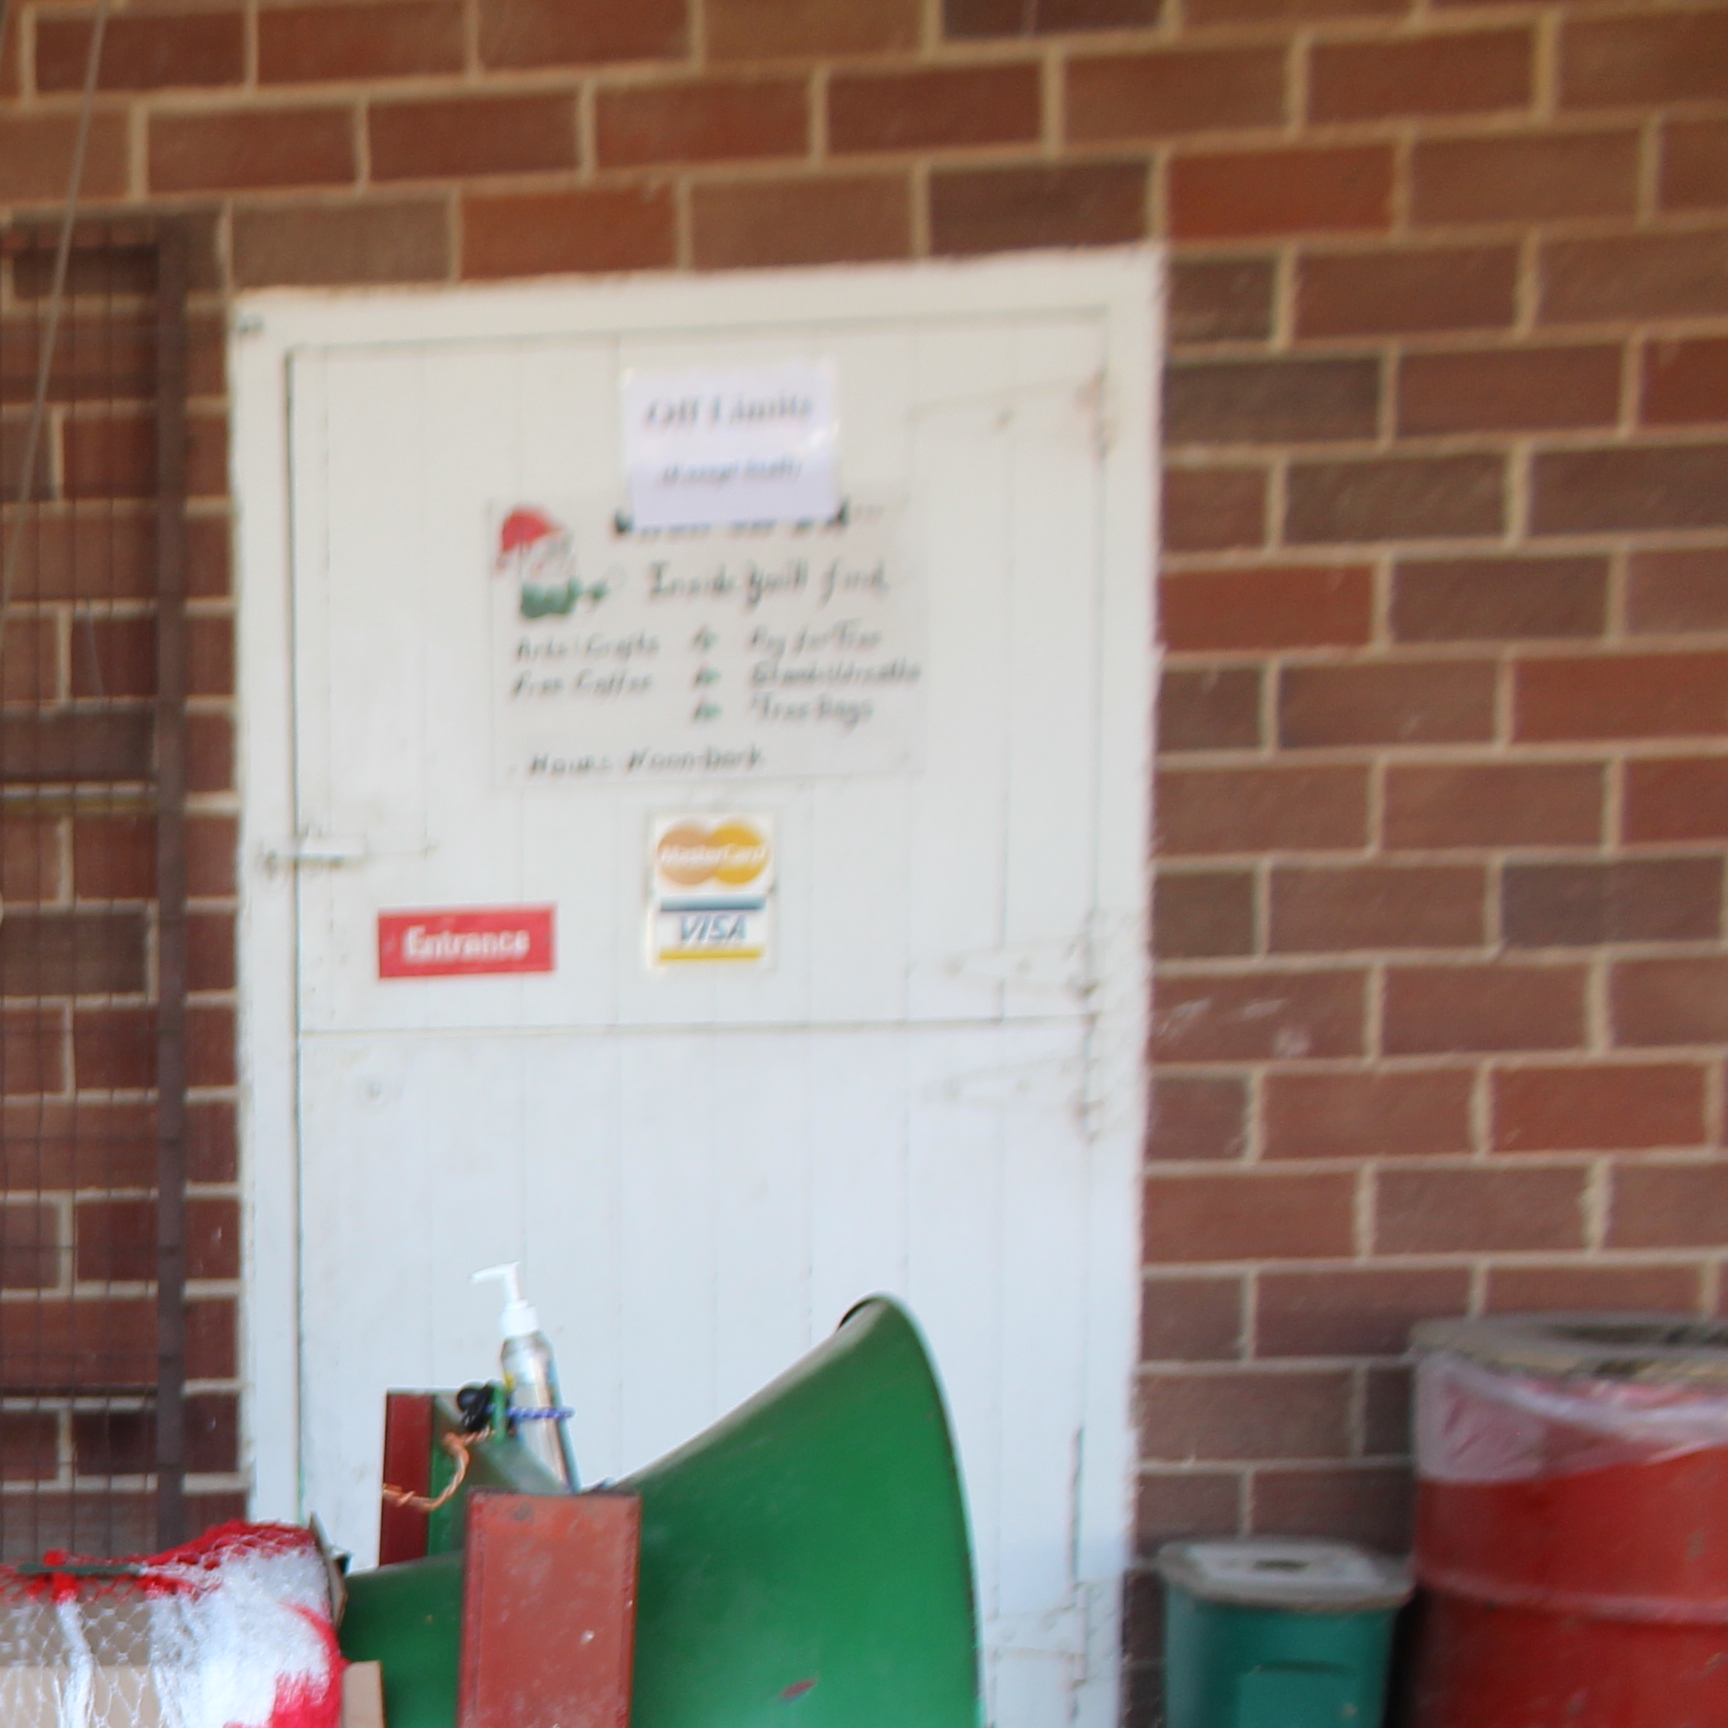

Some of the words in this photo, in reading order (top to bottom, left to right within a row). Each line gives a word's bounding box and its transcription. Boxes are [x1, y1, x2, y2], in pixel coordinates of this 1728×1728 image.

[646, 394, 700, 426] Off
[710, 392, 813, 423] Limits
[575, 667, 654, 698] Coffee
[658, 837, 768, 867] MasterCard
[678, 914, 749, 943] VISA
[402, 926, 530, 966] Entrance
